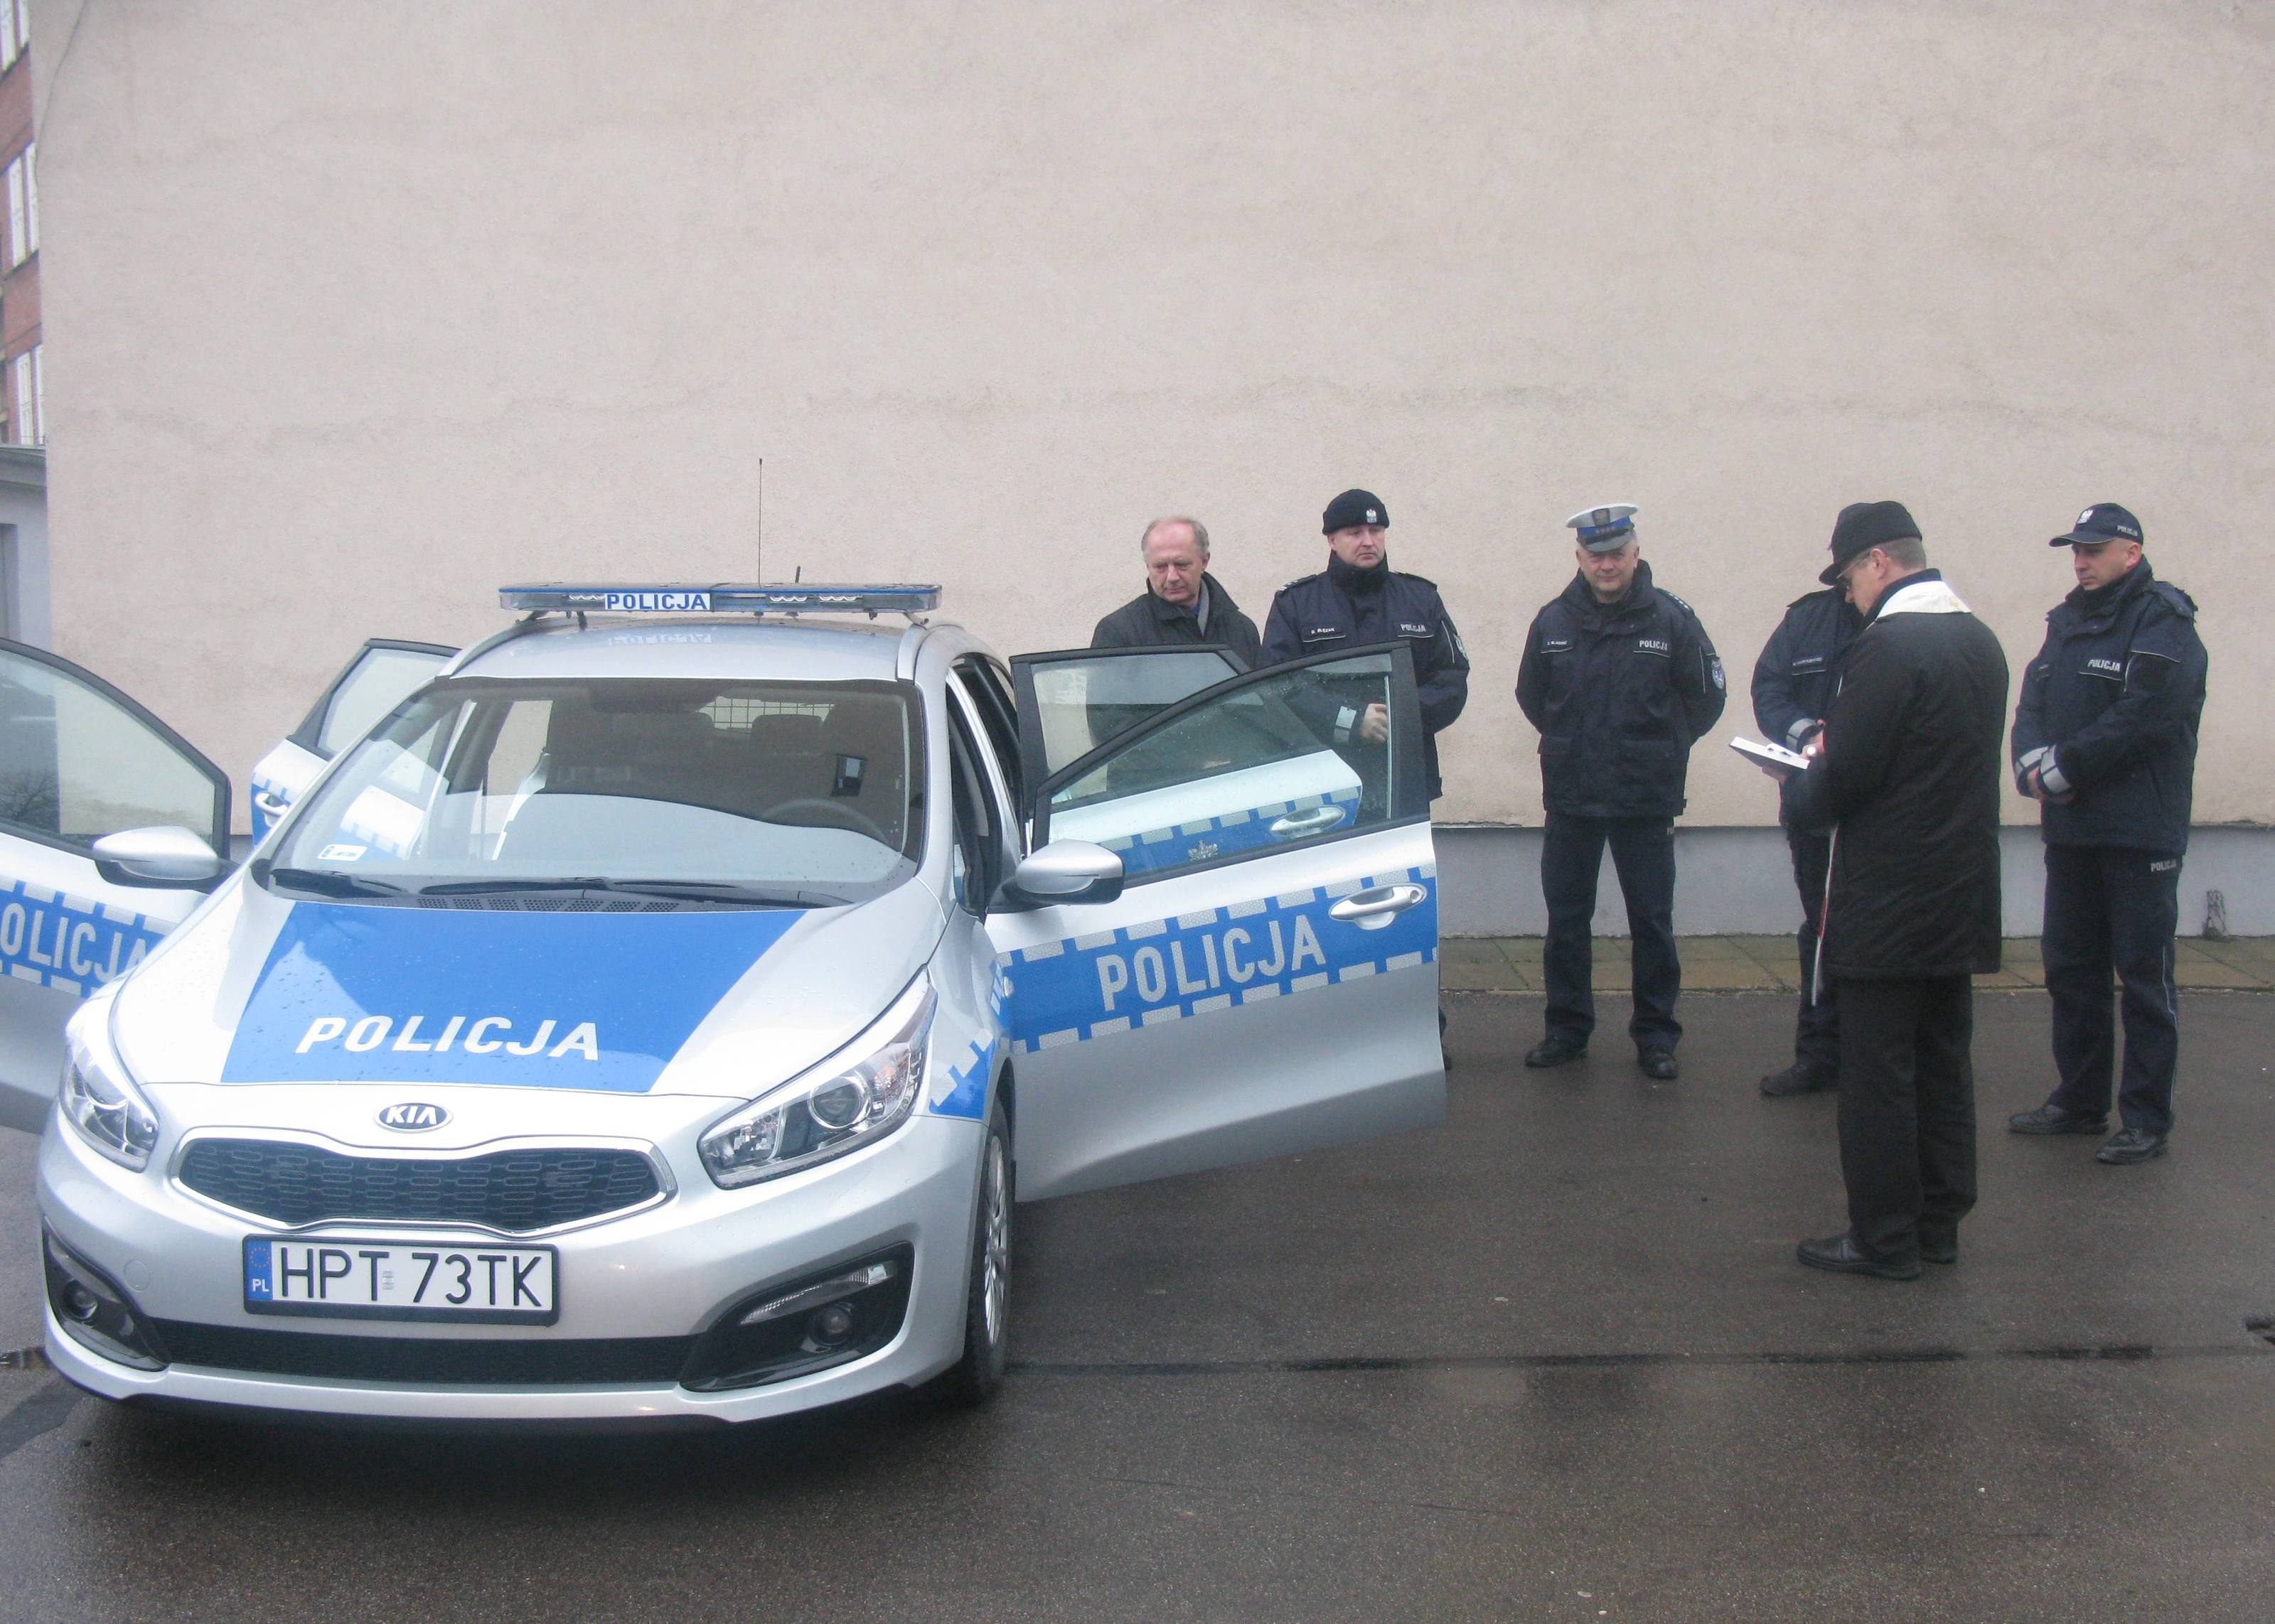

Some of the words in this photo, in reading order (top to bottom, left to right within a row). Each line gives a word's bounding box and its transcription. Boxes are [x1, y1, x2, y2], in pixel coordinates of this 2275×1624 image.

[606, 594, 707, 610] POLICJA
[1639, 640, 1668, 652] POLICJA
[2087, 659, 2121, 673] POLICJA
[0, 902, 147, 984] OLICJA
[1096, 914, 1327, 1012] POLICJA
[295, 1015, 599, 1061] POLICJA
[386, 1105, 437, 1125] KIA
[252, 1278, 270, 1293] PL
[281, 1247, 390, 1302] HPT
[412, 1252, 543, 1308] 73TK
